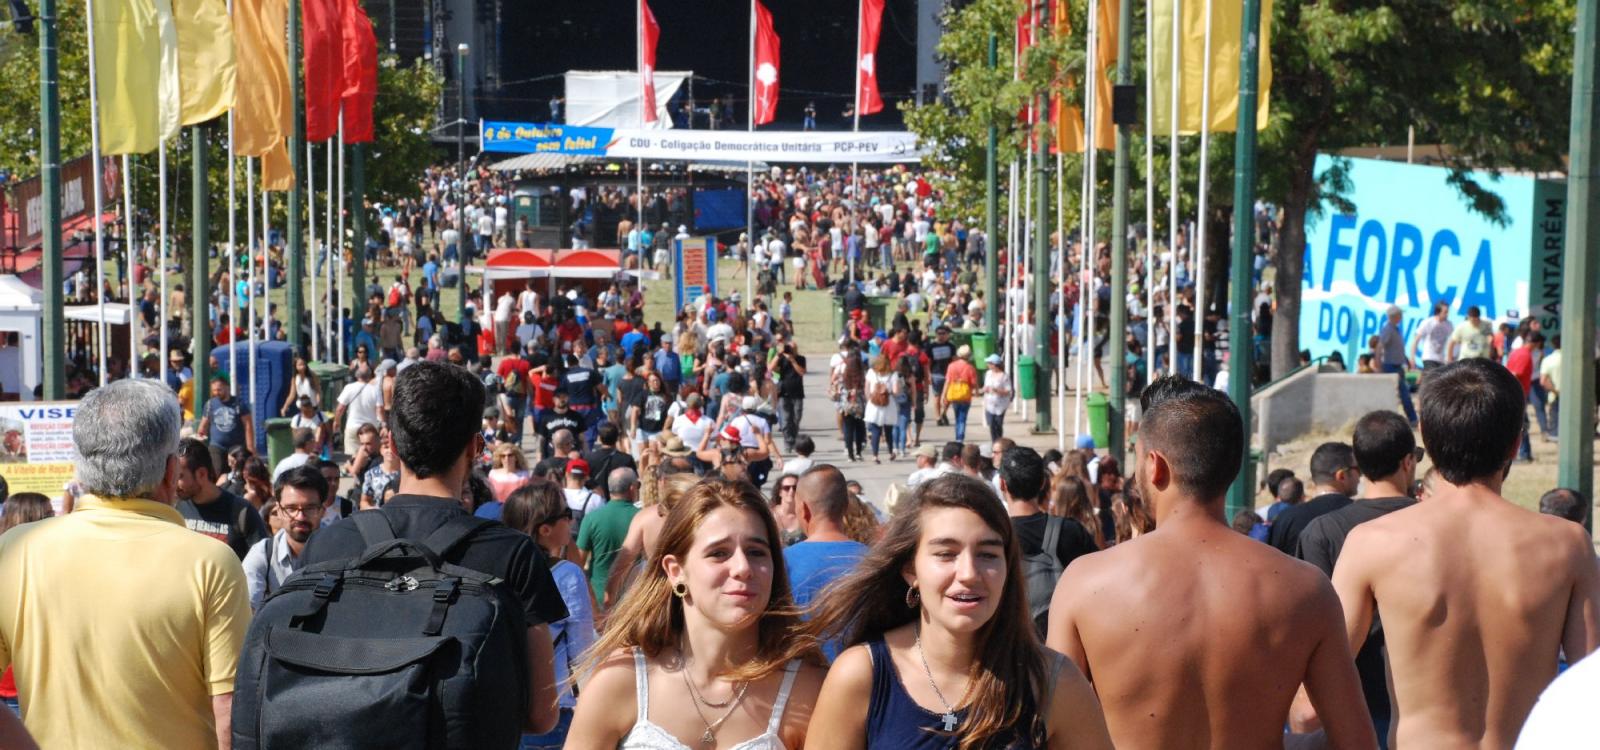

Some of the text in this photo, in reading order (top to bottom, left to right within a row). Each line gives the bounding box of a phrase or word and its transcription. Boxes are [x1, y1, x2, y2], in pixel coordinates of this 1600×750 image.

[485, 127, 494, 140] 4
[496, 126, 511, 139] de
[630, 137, 651, 148] CDU
[660, 138, 711, 152] Coligação
[714, 140, 778, 152] Democrática
[781, 141, 822, 152] Unitária
[834, 141, 879, 152] PCP-PEV
[1540, 198, 1562, 330] SANTARÉM
[1318, 301, 1352, 344] DO
[19, 408, 77, 419] VISE
